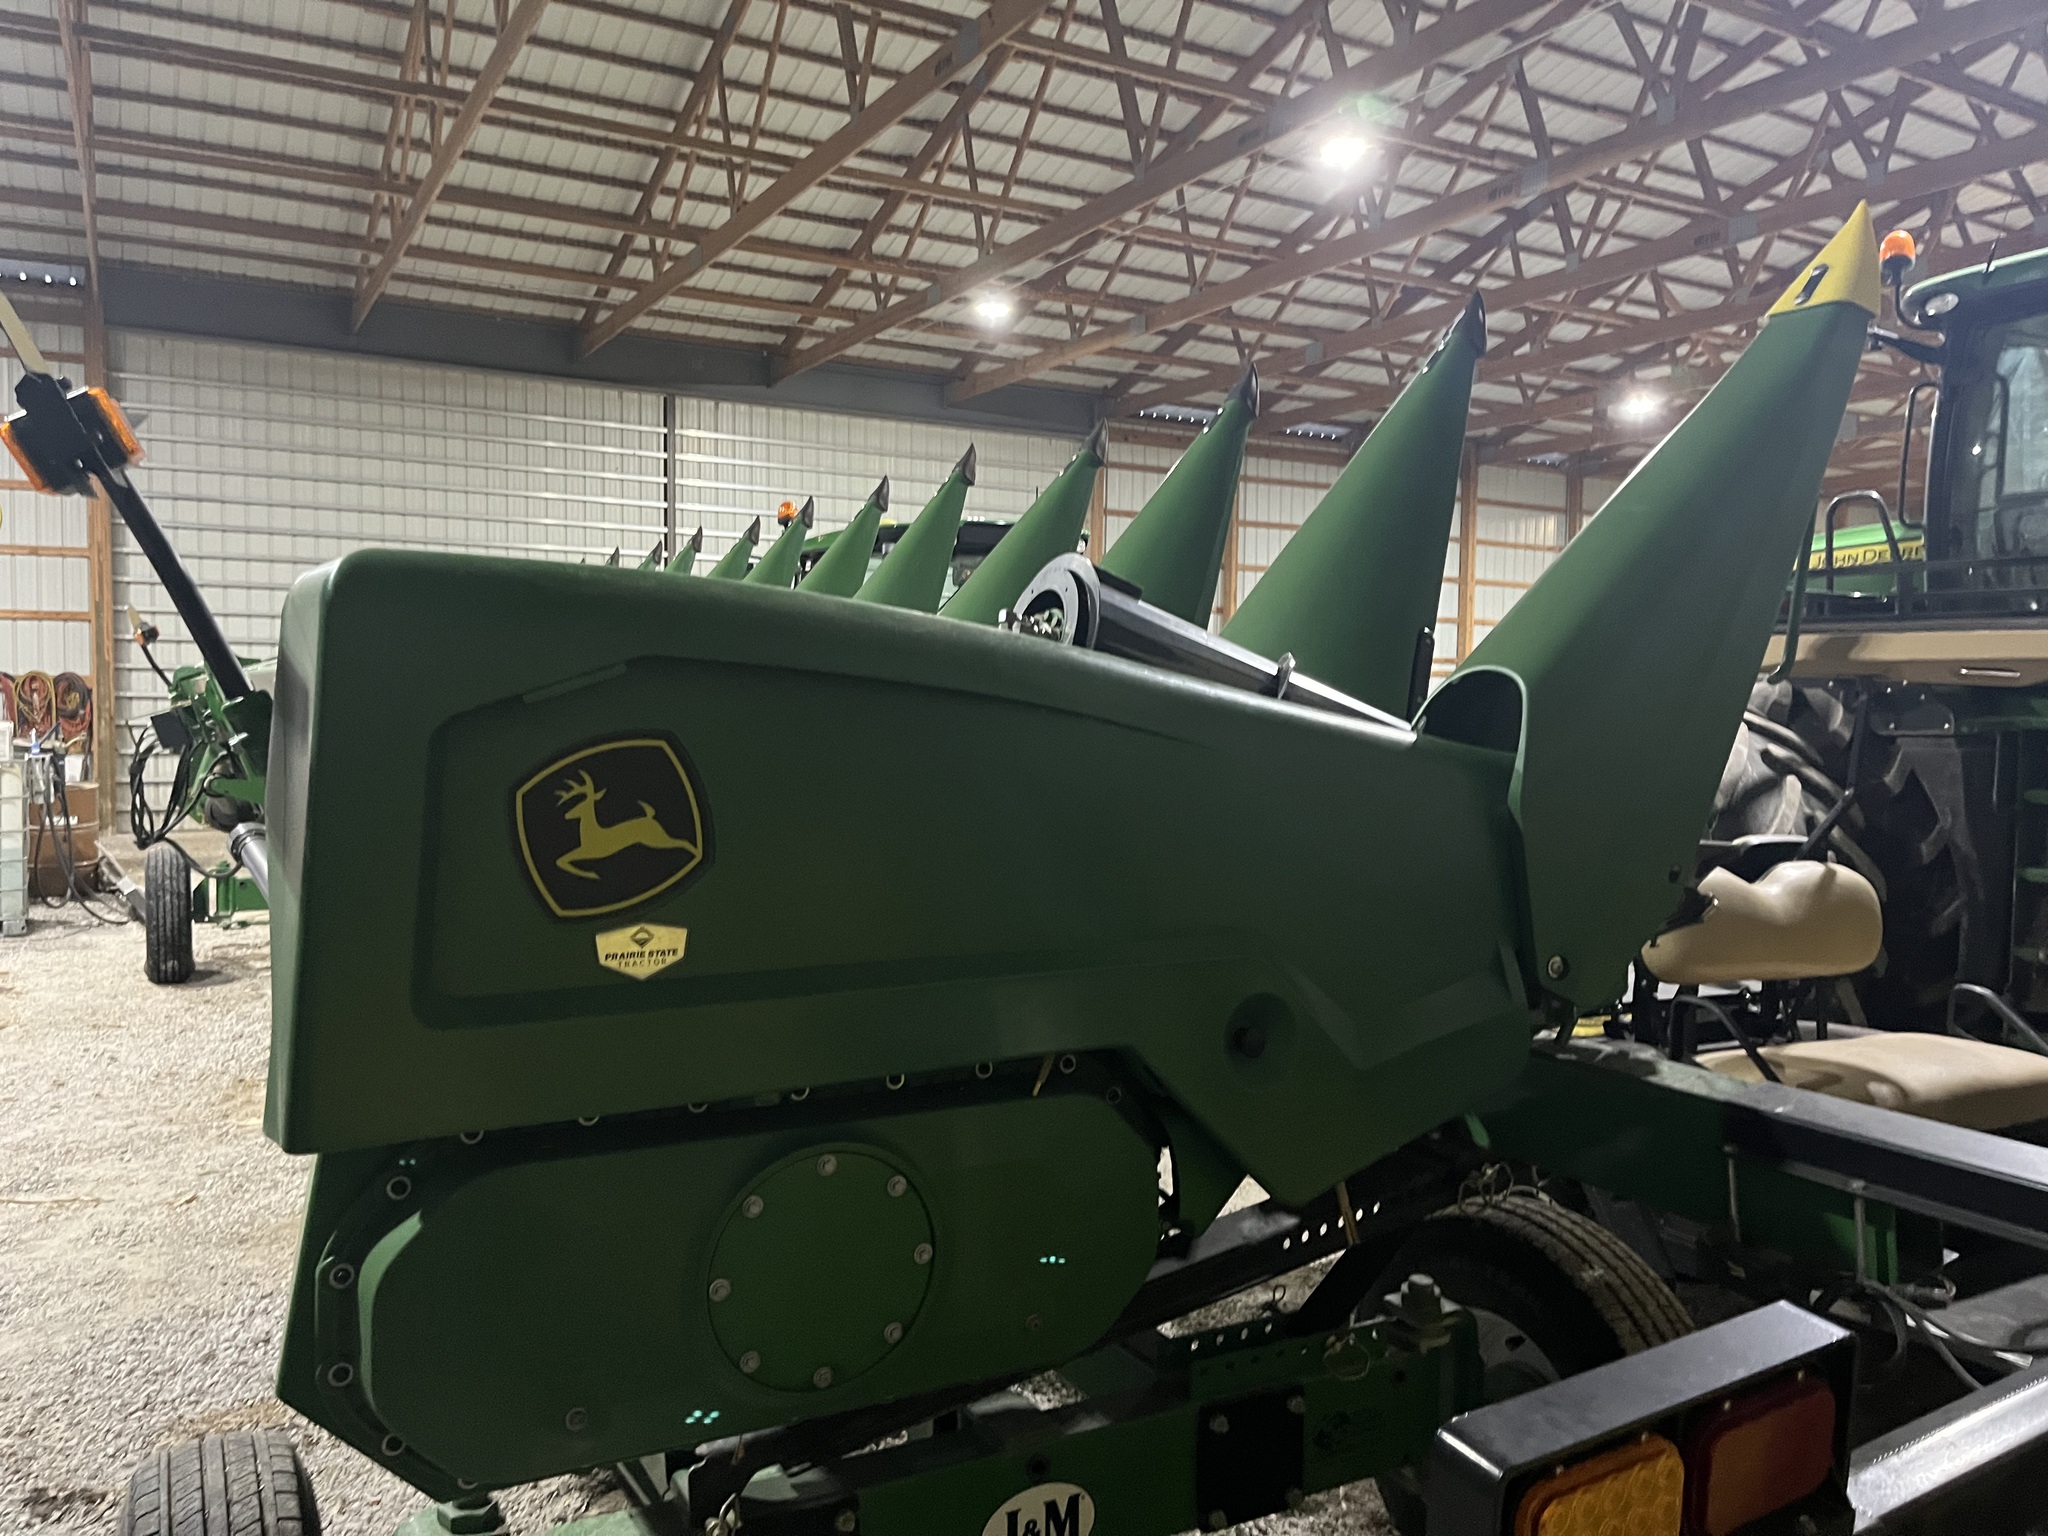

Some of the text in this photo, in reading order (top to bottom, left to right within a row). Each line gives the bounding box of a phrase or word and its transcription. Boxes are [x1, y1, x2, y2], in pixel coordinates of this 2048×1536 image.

[1816, 552, 1859, 568] JHN
[604, 948, 679, 961] PRAIRIE STATE
[618, 959, 667, 968] TRACTOR
